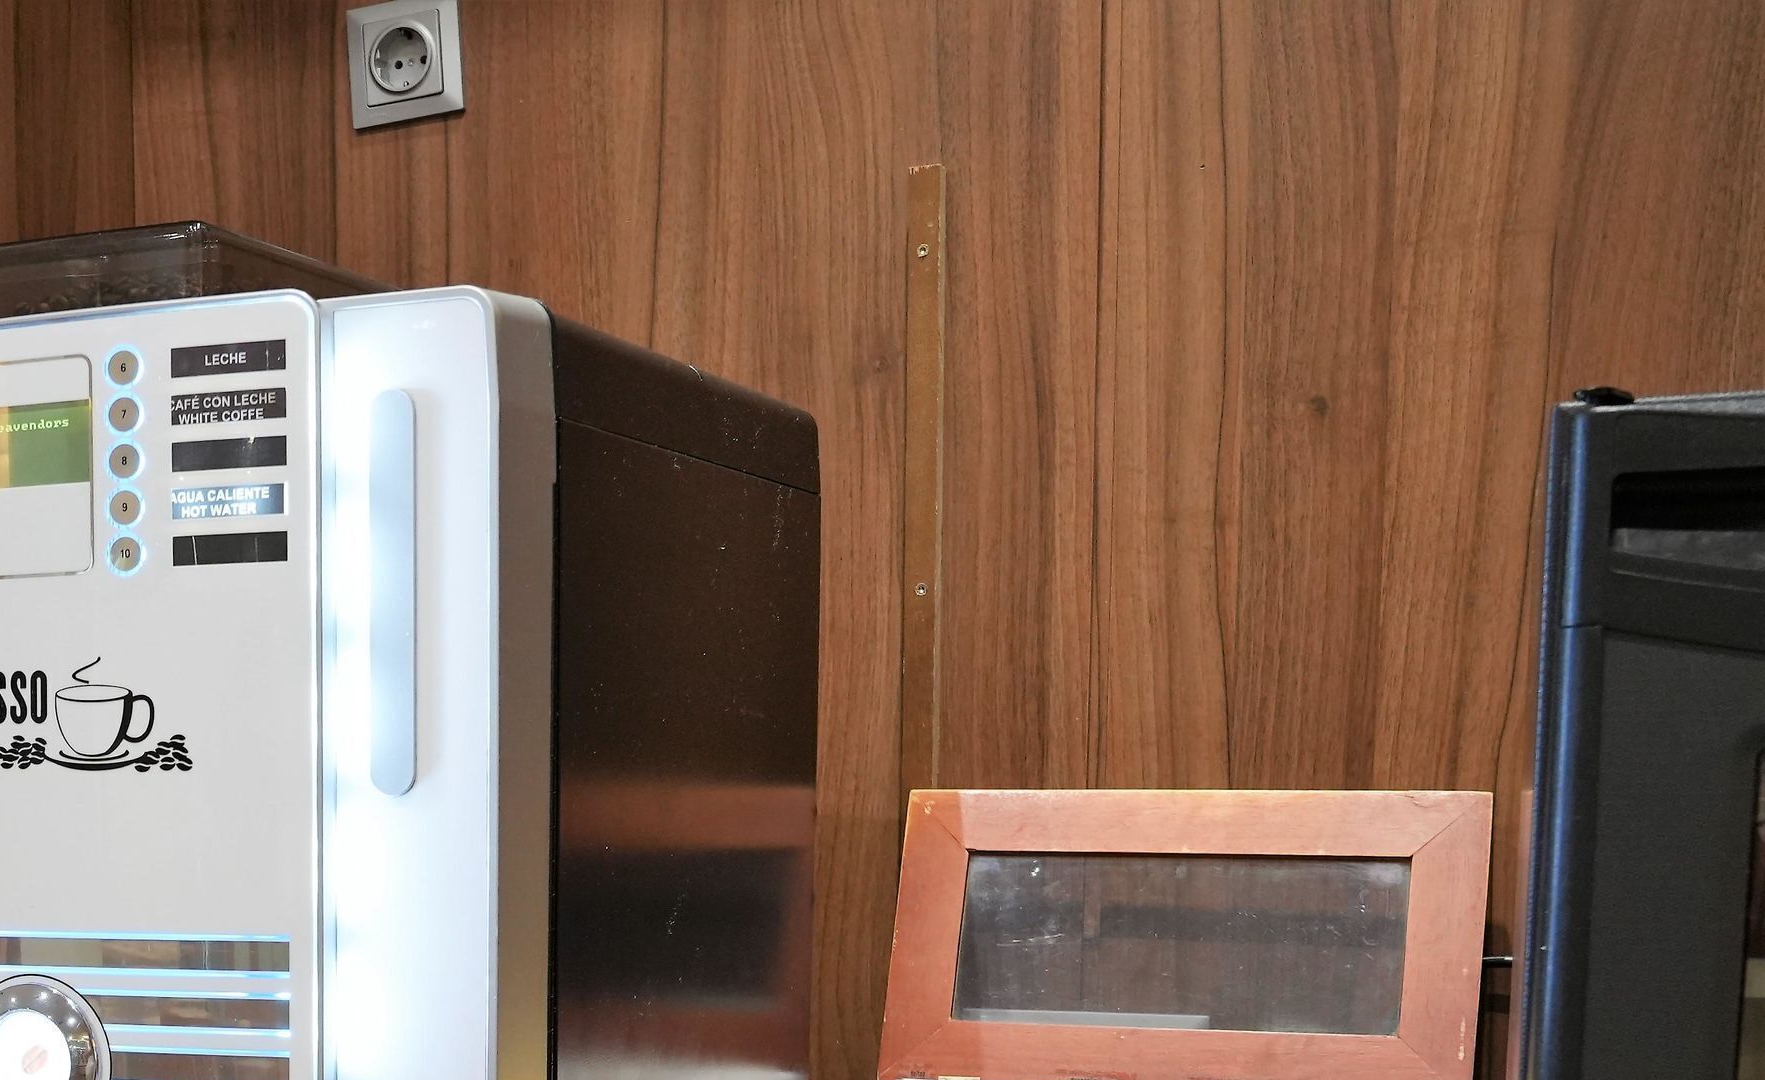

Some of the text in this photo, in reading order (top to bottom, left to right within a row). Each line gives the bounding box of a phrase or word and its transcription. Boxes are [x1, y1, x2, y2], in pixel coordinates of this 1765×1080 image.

[204, 351, 247, 367] LECHE
[120, 362, 127, 373] 6
[203, 395, 231, 409] CON
[234, 391, 276, 407] LECHE
[121, 409, 127, 420] 7
[178, 408, 264, 425] WHITE COFFE
[121, 456, 127, 466] 8
[171, 486, 270, 504] AGUA CALIENTE
[122, 502, 128, 512] 9
[181, 501, 257, 518] HOT WATER
[120, 549, 131, 559] 10
